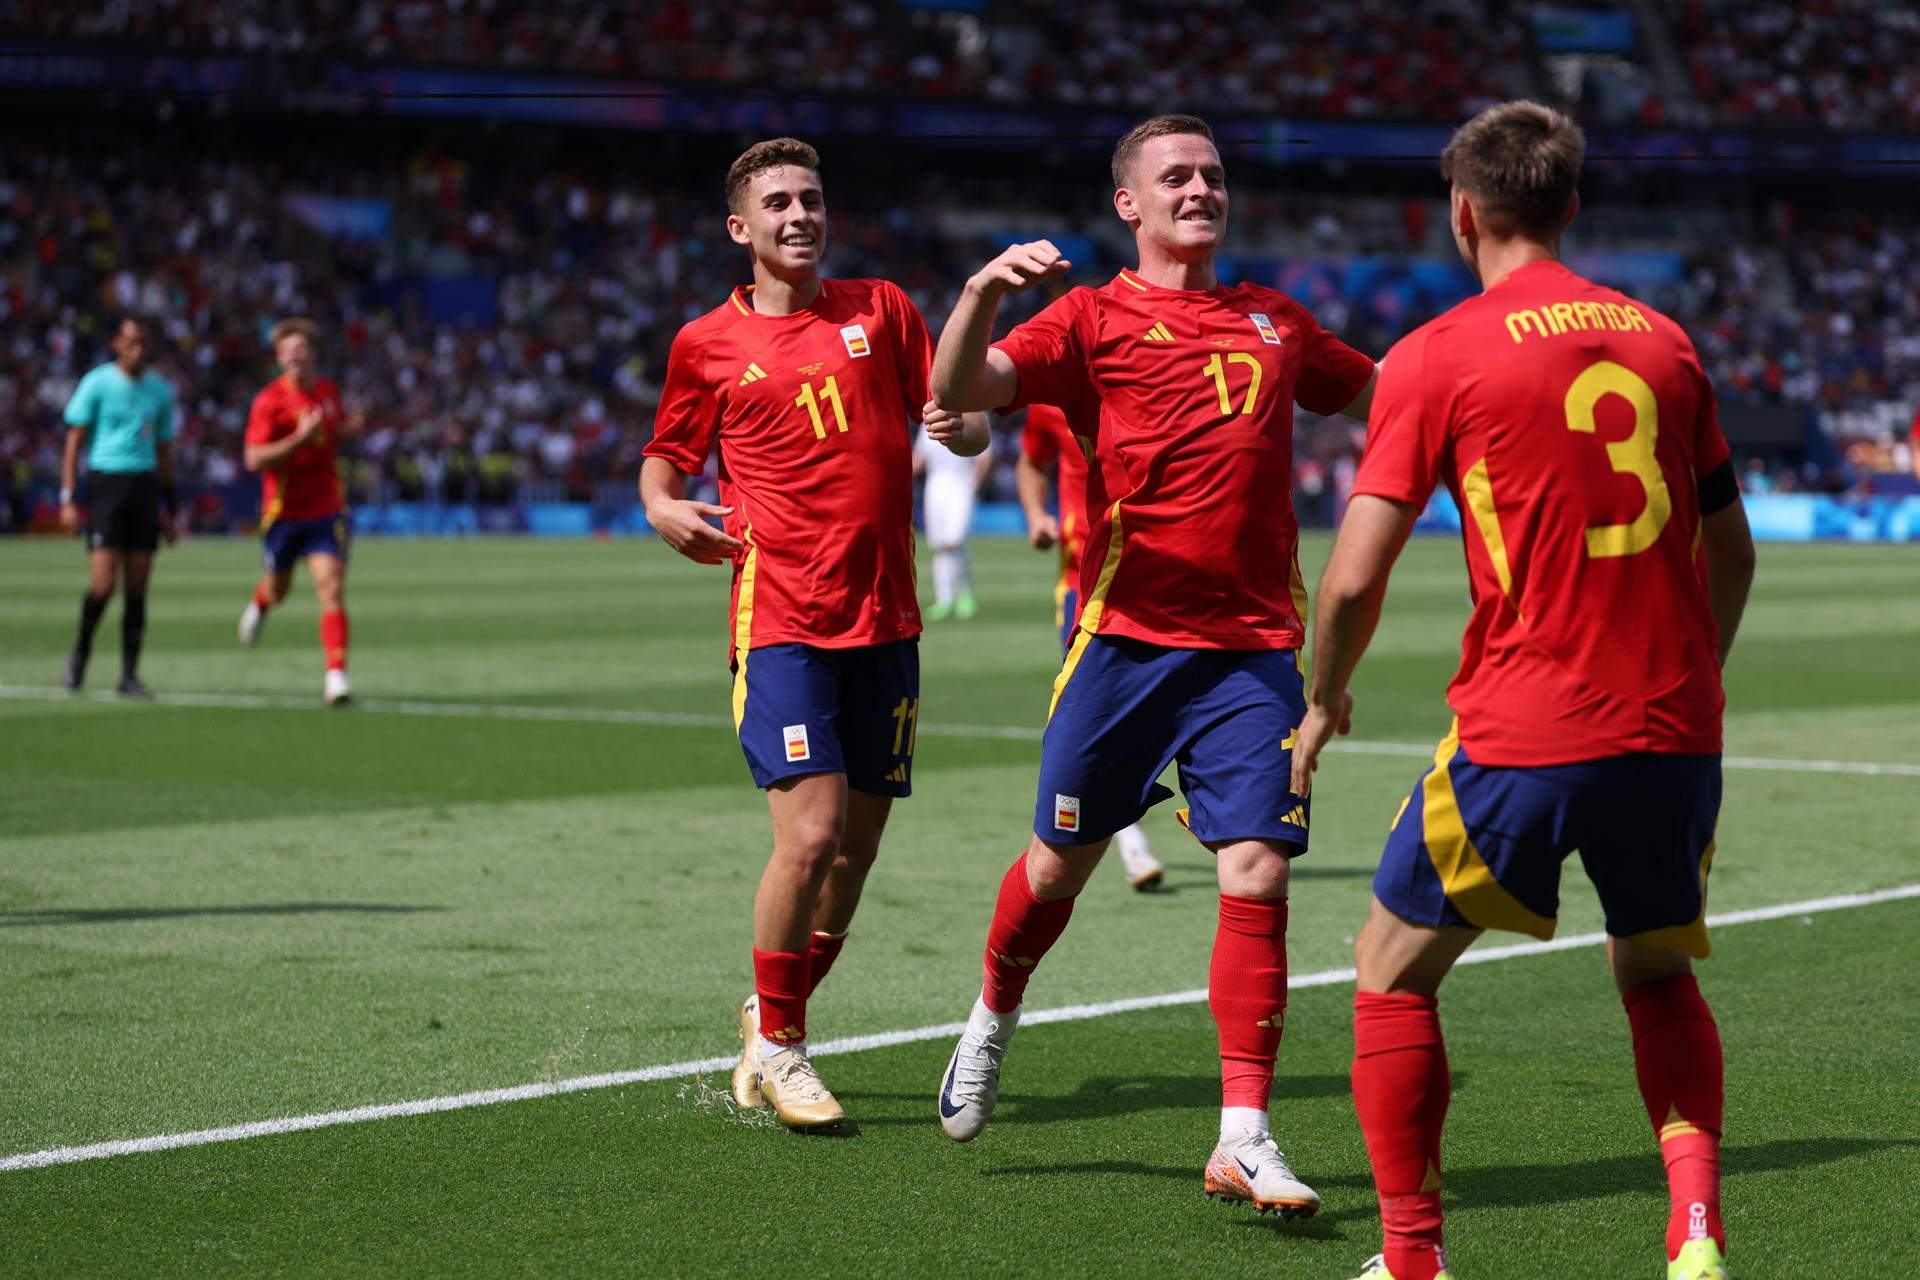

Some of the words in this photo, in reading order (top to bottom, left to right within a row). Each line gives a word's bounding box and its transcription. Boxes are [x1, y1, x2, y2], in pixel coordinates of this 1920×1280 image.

[1504, 302, 1652, 344] MIRANDA
[794, 374, 849, 440] 11
[1202, 352, 1263, 415] 17
[1564, 360, 1672, 559] 3
[891, 696, 919, 757] 11
